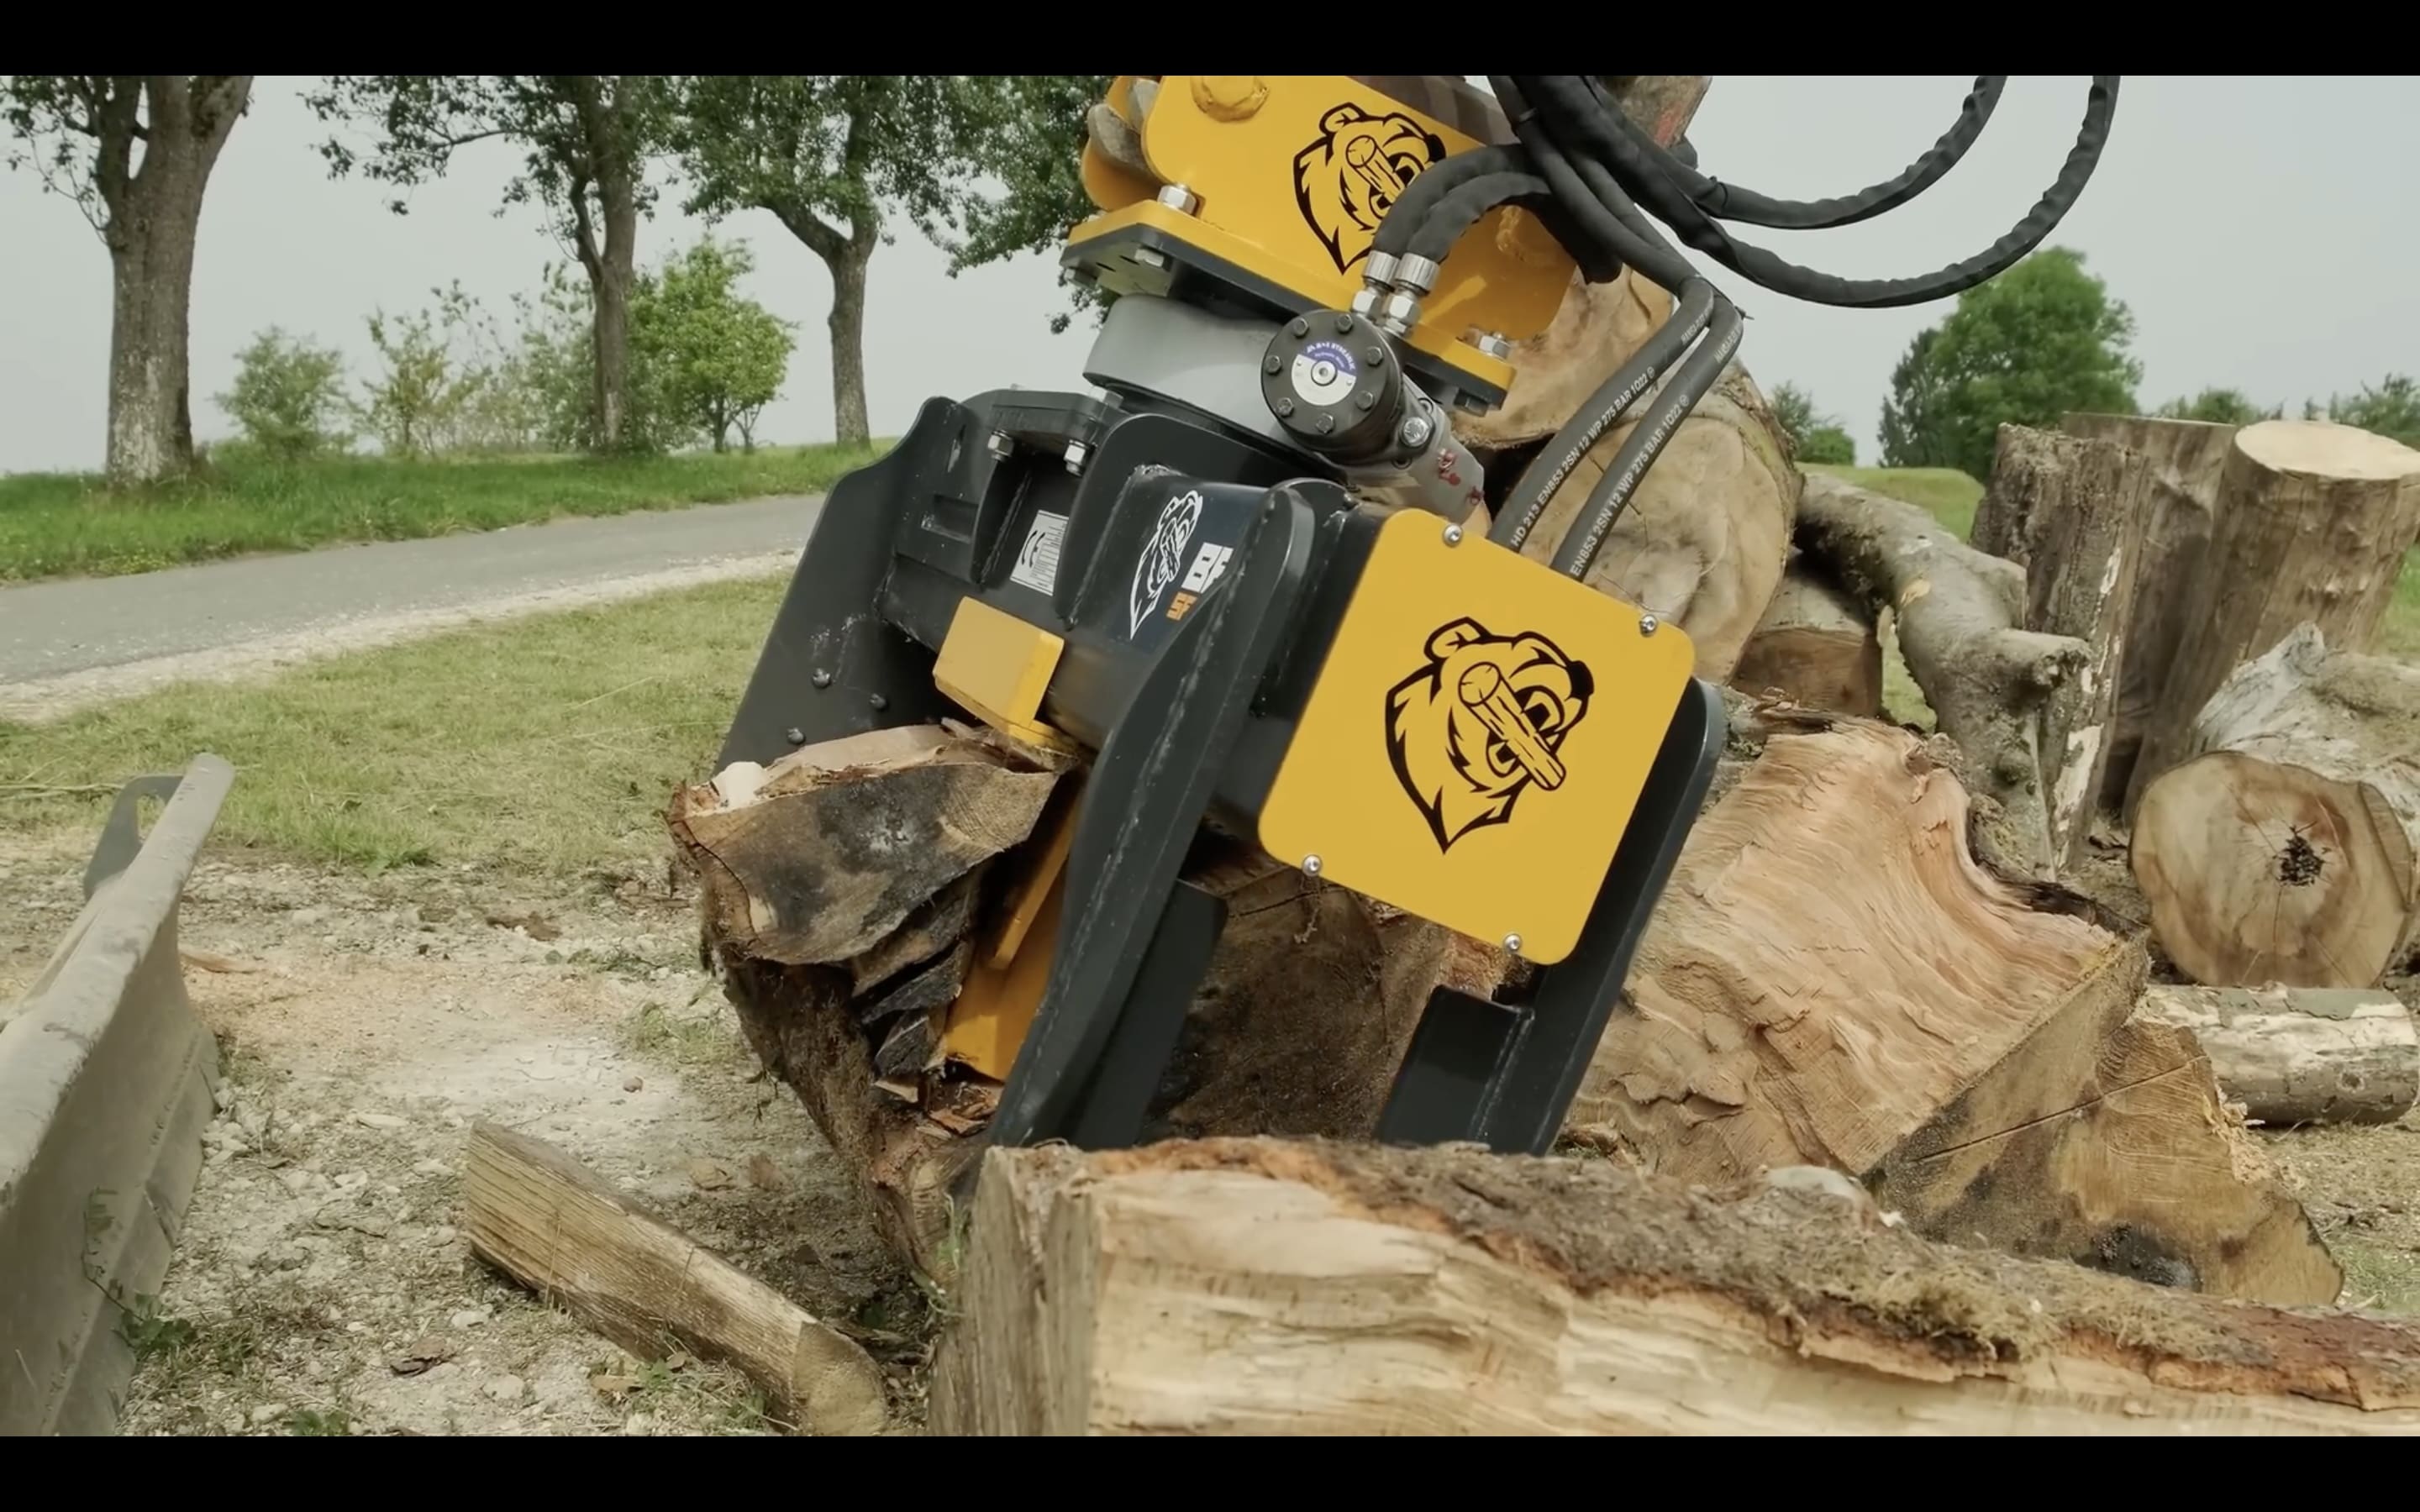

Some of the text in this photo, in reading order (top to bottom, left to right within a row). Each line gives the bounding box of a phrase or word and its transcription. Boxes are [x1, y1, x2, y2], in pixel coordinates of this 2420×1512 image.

[1510, 526, 1527, 547] HD
[1523, 503, 1540, 527] 213
[1537, 468, 1565, 505] EN853
[1562, 446, 1581, 472] 2SN
[1579, 435, 1591, 451] 12
[1586, 421, 1602, 439] WP
[1601, 405, 1617, 426] 275
[1614, 389, 1632, 412] BAR
[1570, 535, 1598, 577] EN853
[1592, 507, 1613, 535] 2SN
[1608, 491, 1623, 508] 12
[1618, 471, 1634, 493] WP
[1632, 451, 1649, 474] 275
[1645, 428, 1665, 454] BAR
